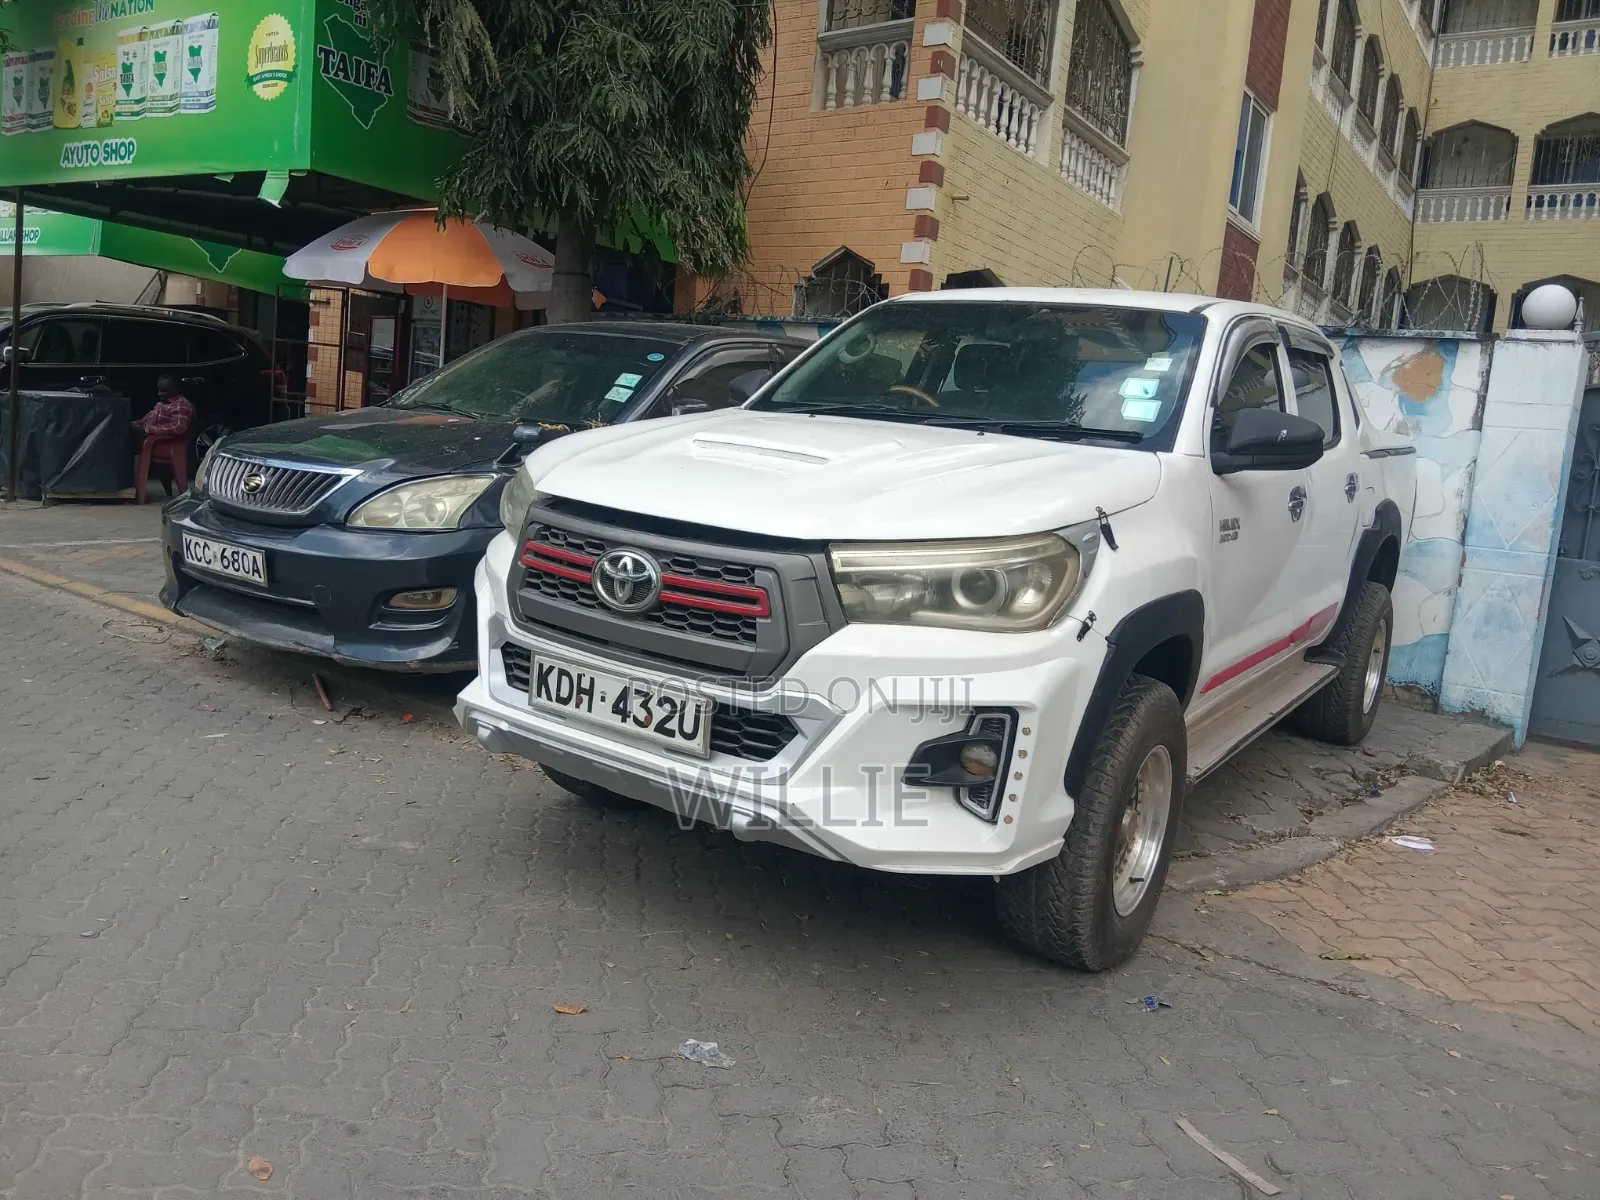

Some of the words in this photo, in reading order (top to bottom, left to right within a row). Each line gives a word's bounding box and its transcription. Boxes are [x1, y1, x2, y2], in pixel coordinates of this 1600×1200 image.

[110, 0, 154, 19] NATION
[336, 0, 367, 12] nga
[255, 40, 289, 68] Superbrands
[317, 45, 394, 96] TAIFA
[61, 143, 100, 165] AYUTO
[102, 140, 136, 163] SHOP
[22, 228, 40, 242] HOP
[184, 538, 212, 565] KCC
[220, 547, 262, 579] 680A
[536, 662, 595, 714] KDH
[611, 684, 702, 741] 432U
